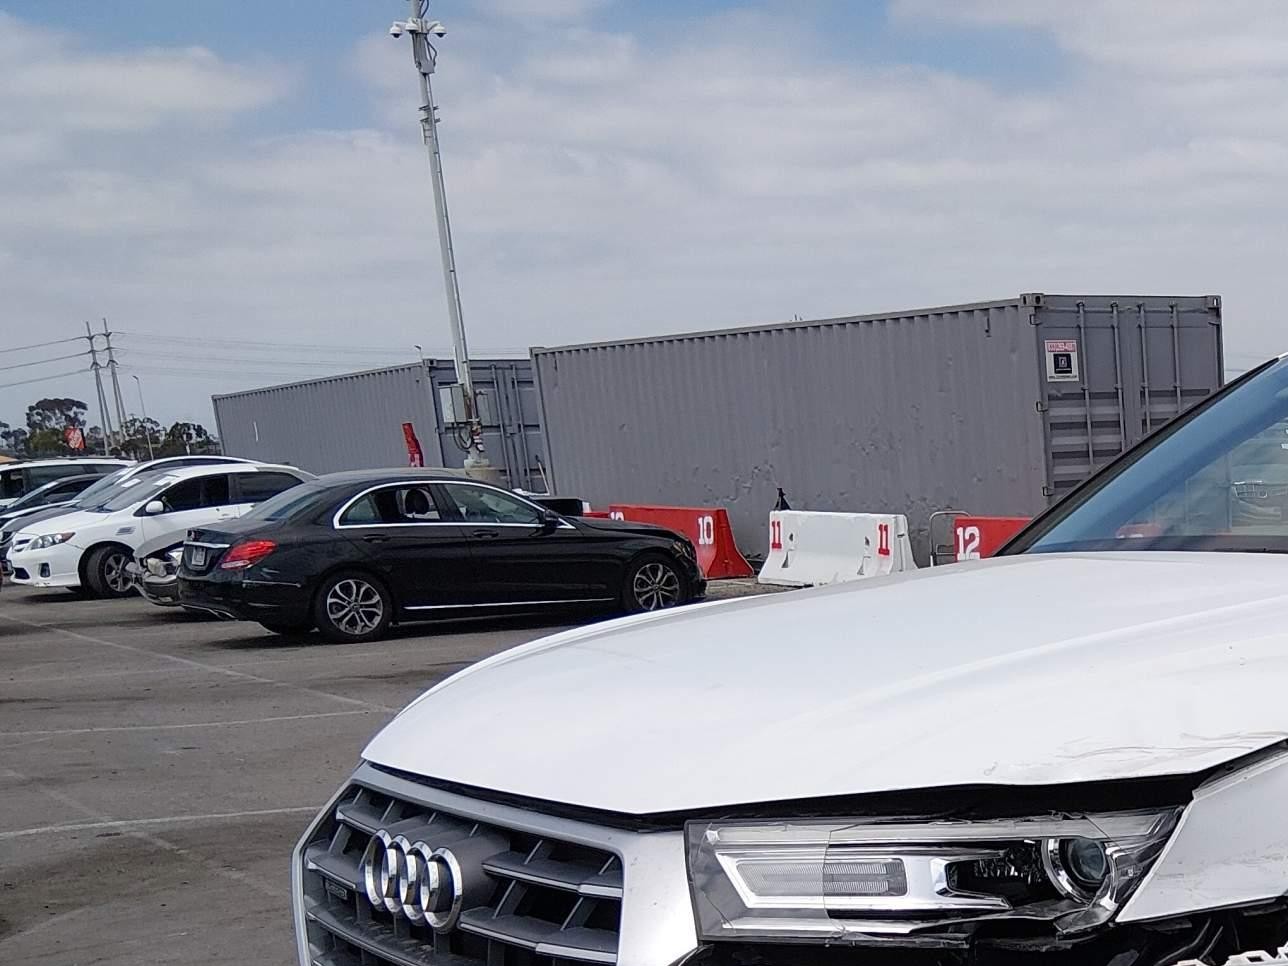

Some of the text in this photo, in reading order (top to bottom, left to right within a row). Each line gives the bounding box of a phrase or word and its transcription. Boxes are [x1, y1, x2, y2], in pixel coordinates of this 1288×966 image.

[697, 515, 715, 545] 10
[771, 520, 782, 549] 11
[878, 523, 890, 556] 11
[956, 525, 981, 561] 12
